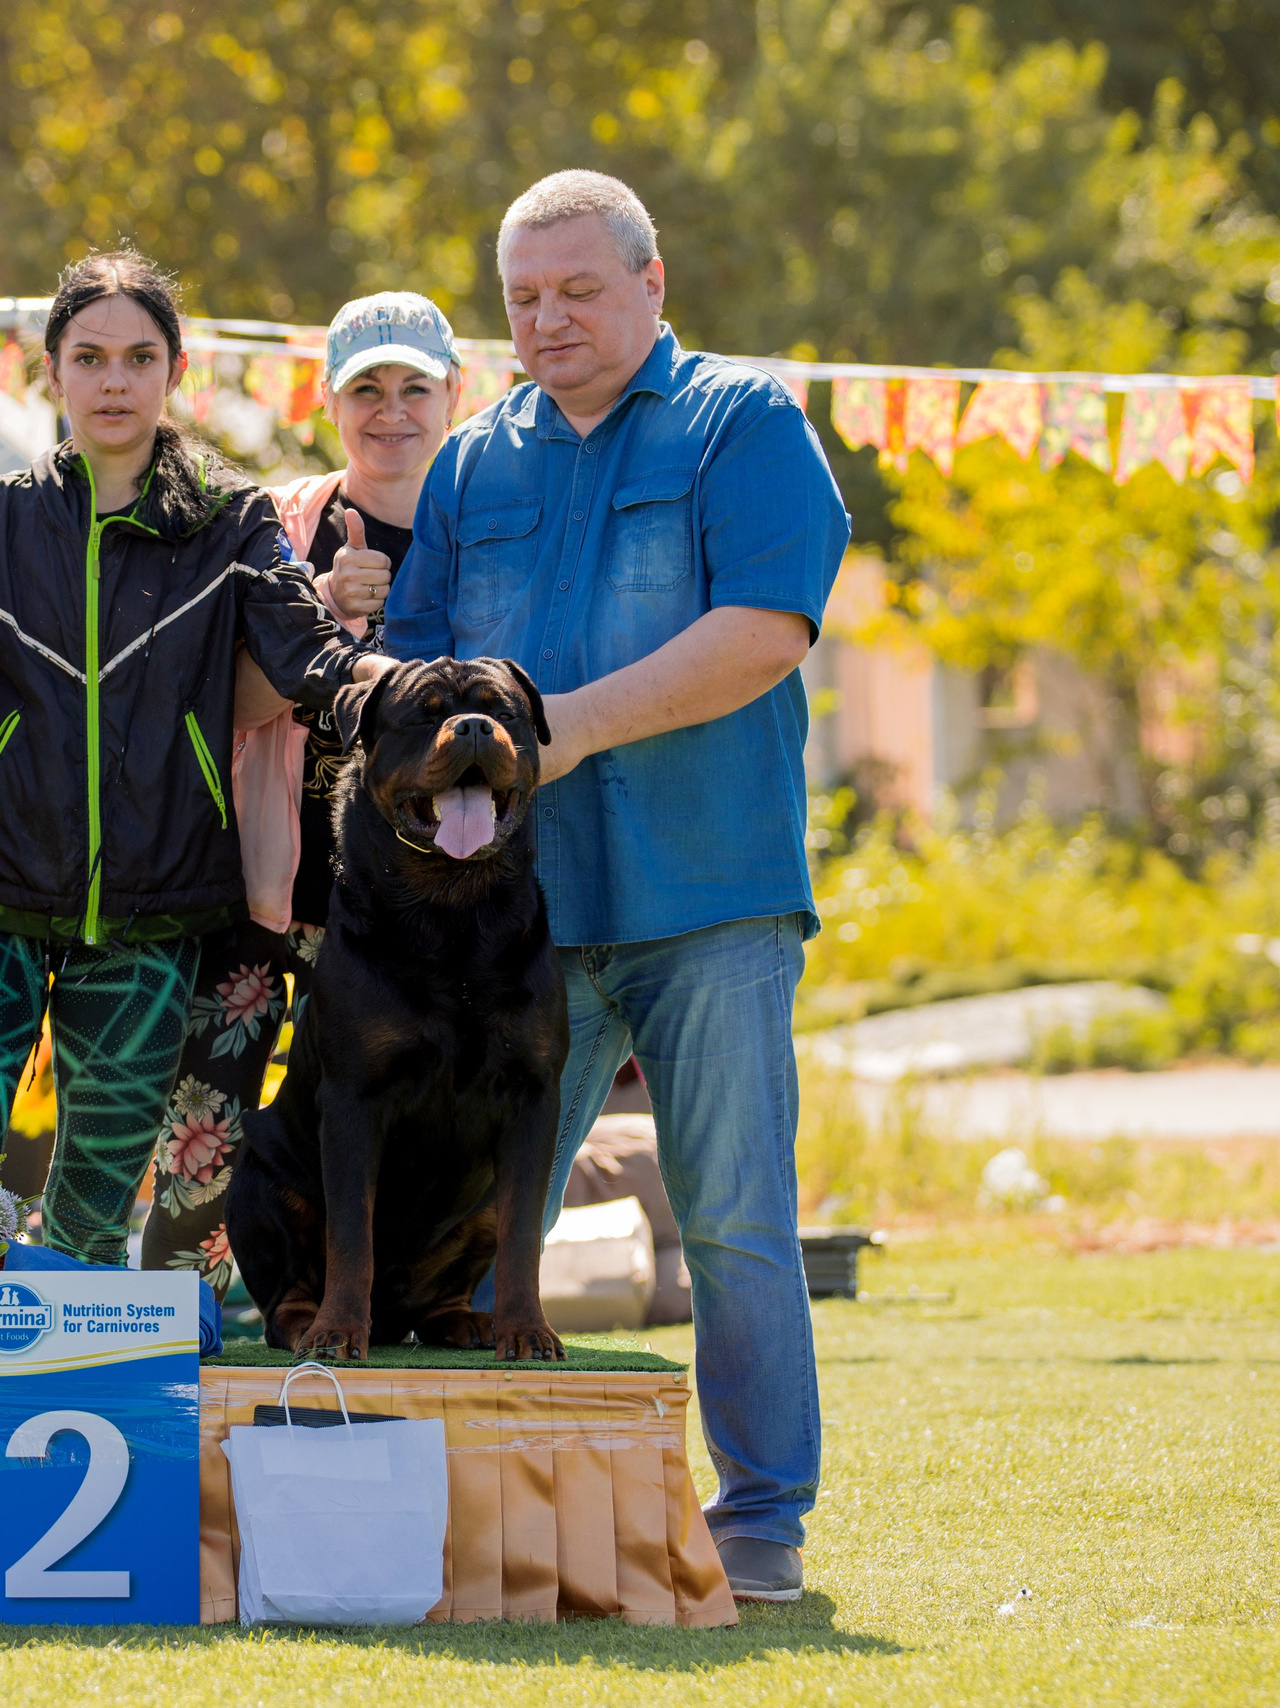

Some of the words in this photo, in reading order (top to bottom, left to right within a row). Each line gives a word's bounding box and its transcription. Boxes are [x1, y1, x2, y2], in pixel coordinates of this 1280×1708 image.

[338, 305, 434, 345] CHICAGO
[63, 1304, 121, 1317] Nutrition
[126, 1304, 175, 1320] System
[63, 1320, 82, 1333] for
[87, 1320, 160, 1333] Carnivores
[6, 1332, 30, 1342] Foods
[5, 1410, 130, 1598] 2
